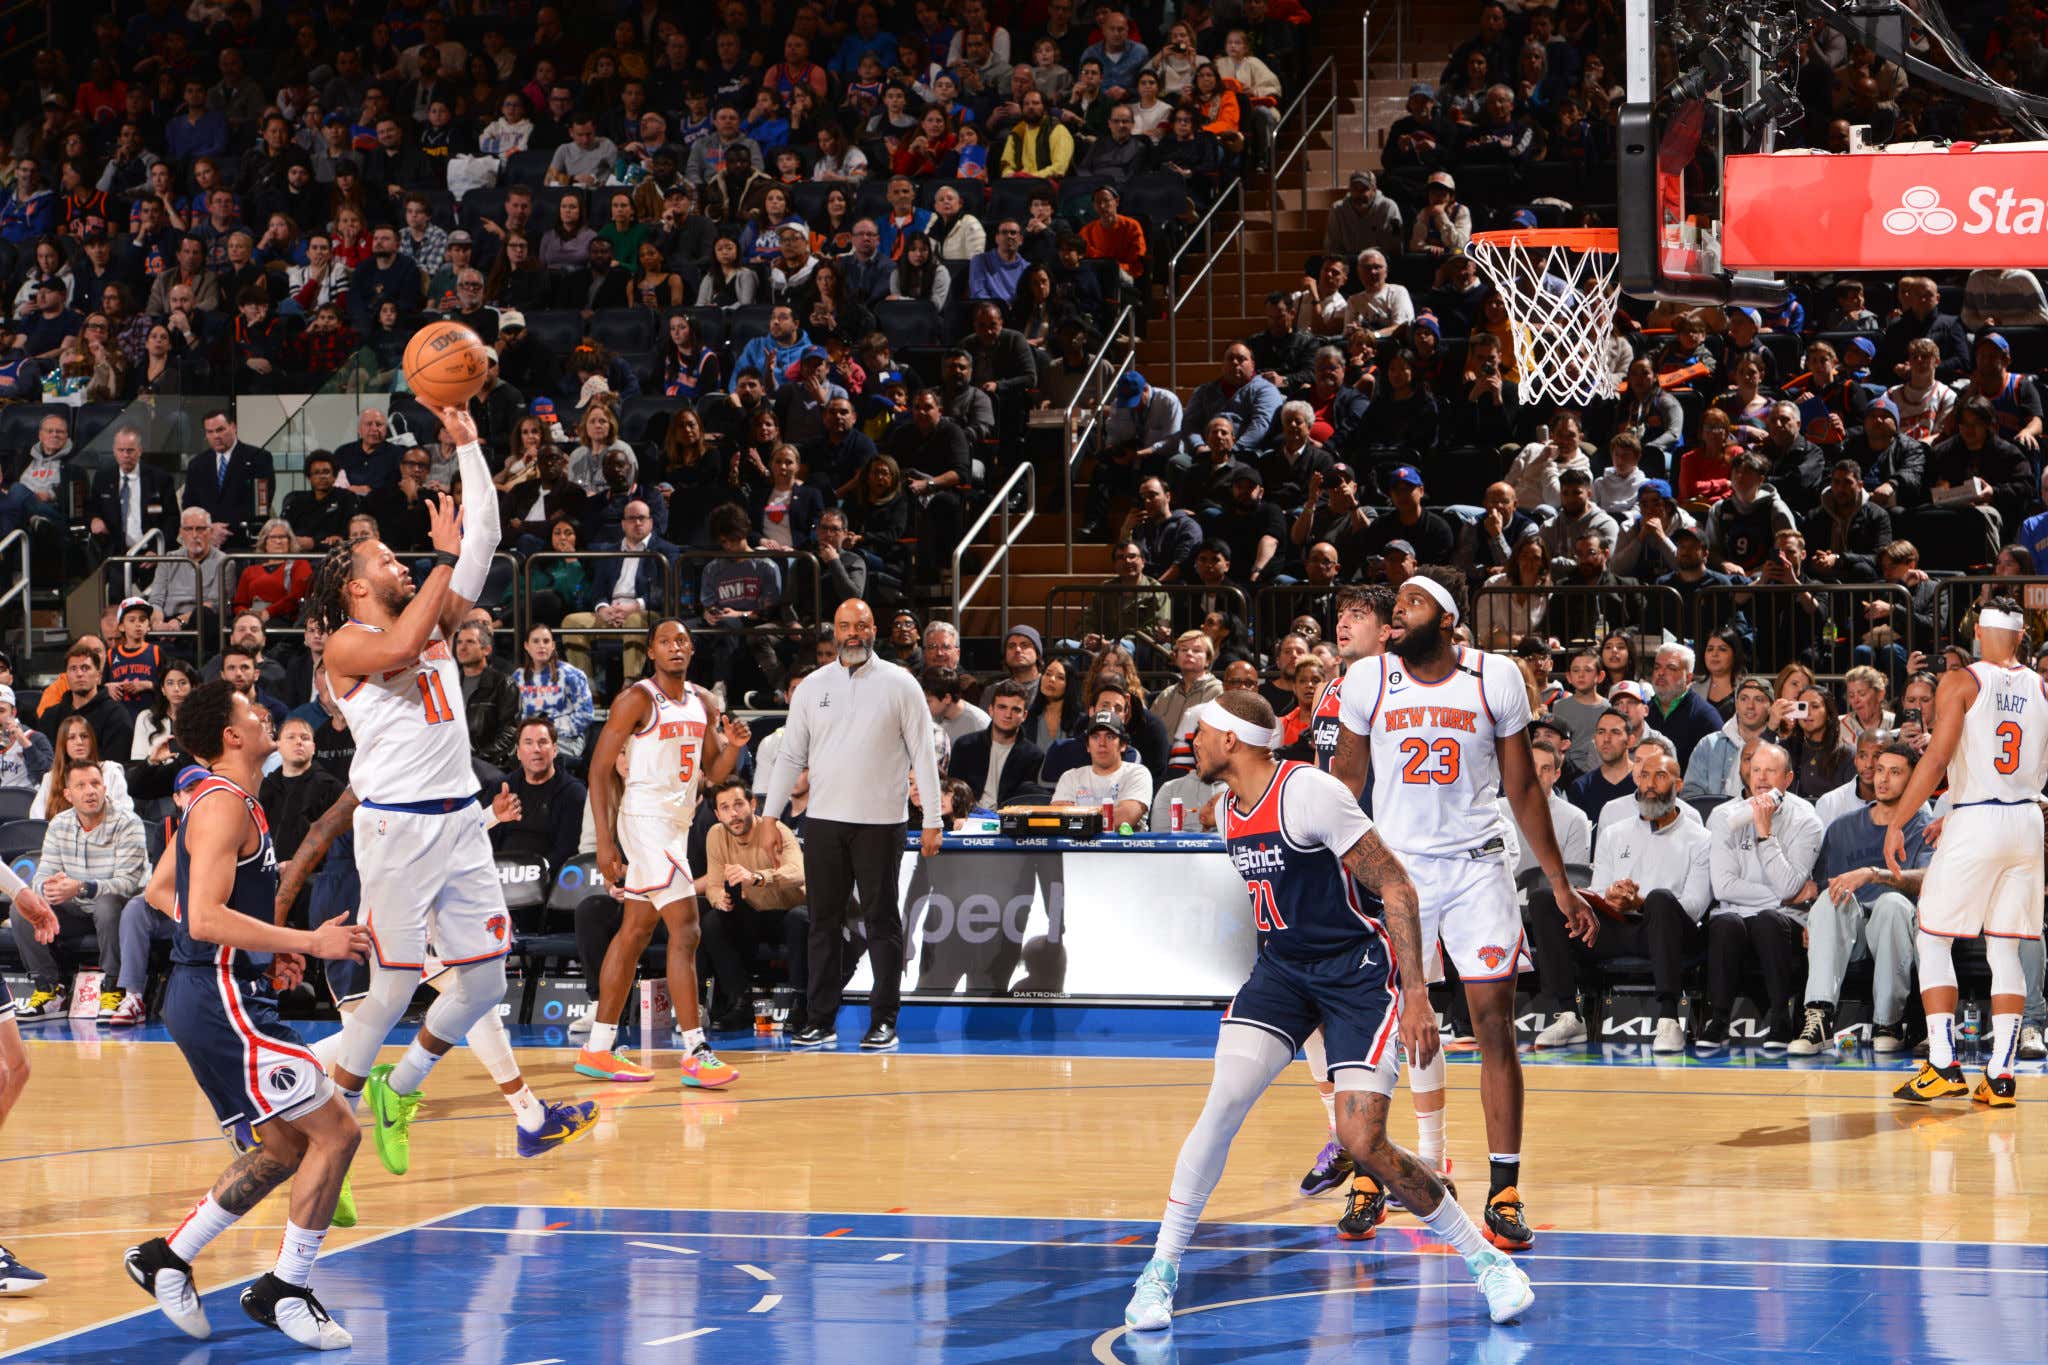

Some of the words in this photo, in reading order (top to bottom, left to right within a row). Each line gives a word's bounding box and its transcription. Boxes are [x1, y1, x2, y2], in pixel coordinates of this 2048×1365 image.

[1962, 186, 2048, 235] Sta
[2028, 587, 2048, 605] 10
[129, 664, 152, 676] YORK
[1390, 672, 1402, 685] 6
[417, 669, 455, 725] 11
[1996, 692, 2028, 714] HART
[1385, 706, 1426, 733] NEW
[1427, 706, 1477, 735] YORK
[659, 721, 686, 741] NEW
[1993, 720, 2023, 775] 3
[679, 744, 695, 782] 5
[1400, 737, 1461, 785] 23
[962, 838, 995, 847] CHASE
[1015, 838, 1048, 847] CHASE
[1068, 840, 1101, 848] CHASE
[1122, 840, 1156, 848] CHASE
[1176, 840, 1209, 848] CHASE
[496, 864, 541, 885] HUB
[1247, 879, 1289, 932] 21
[566, 1003, 592, 1017] HU
